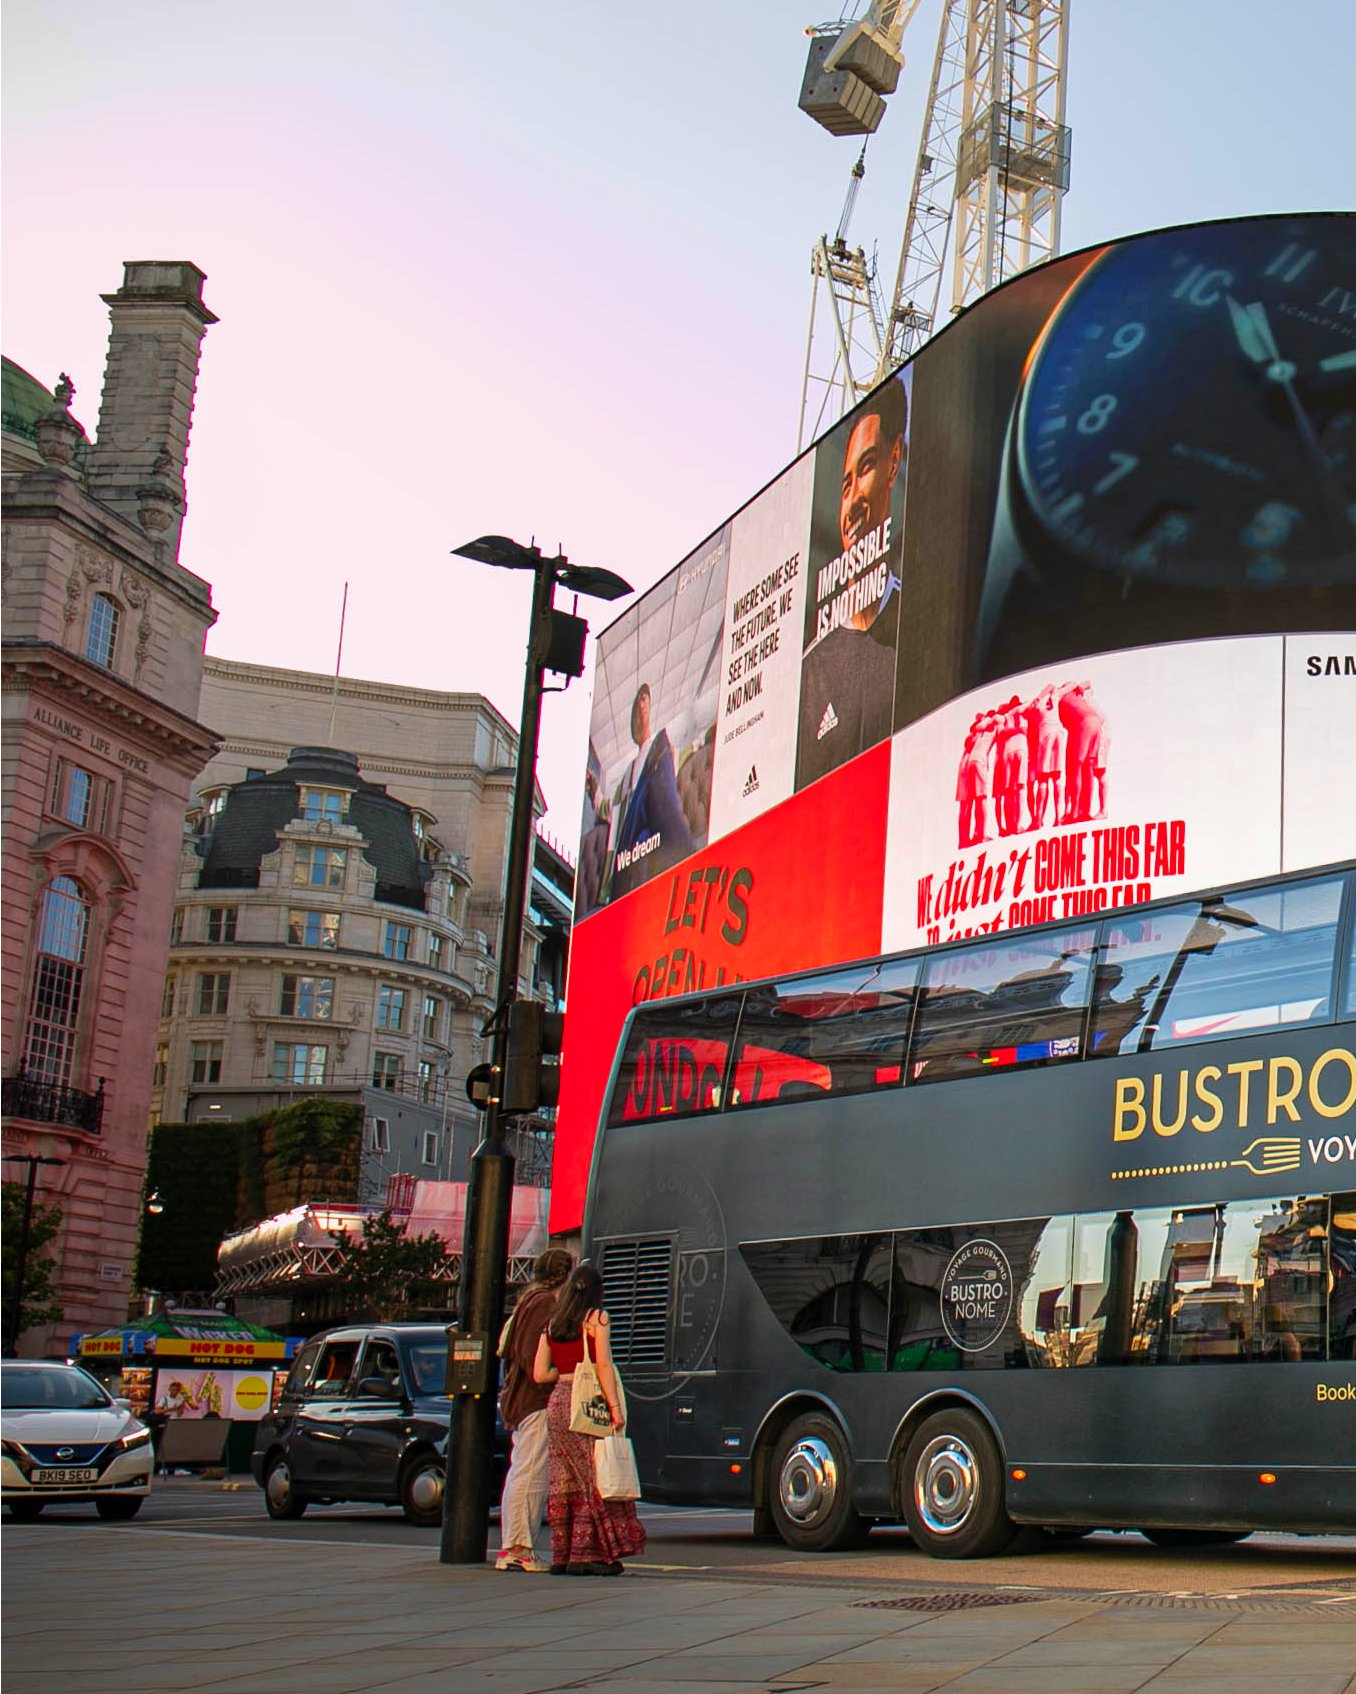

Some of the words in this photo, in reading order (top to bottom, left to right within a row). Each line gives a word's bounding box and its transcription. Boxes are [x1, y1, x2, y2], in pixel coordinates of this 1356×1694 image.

[1105, 322, 1147, 360] 9
[1077, 394, 1118, 434] 8
[1092, 451, 1140, 497] 7
[817, 516, 892, 603] IMPOSSIBLE
[733, 585, 760, 624] WHERE
[760, 565, 784, 603] SOME
[784, 552, 800, 585] SEE
[816, 604, 830, 642] IS
[830, 562, 887, 632] NOTHING
[731, 625, 746, 654] THE
[779, 587, 794, 618] WE
[728, 656, 743, 685] SEE
[743, 644, 759, 675] THE
[759, 628, 780, 664] HERE
[726, 686, 743, 717] AND
[743, 671, 763, 703] NOW.
[33, 707, 83, 741] ALLIANCE
[90, 734, 111, 755] LIFE
[117, 749, 148, 774] OFFICE
[617, 849, 631, 872] We
[631, 832, 661, 863] dream
[917, 874, 933, 929] WE
[1034, 832, 1087, 893] COME
[1092, 824, 1140, 884] THIS
[1143, 820, 1185, 877] FAR
[664, 866, 754, 946] LET'S
[947, 1249, 971, 1282] VOYAGE
[972, 1246, 1008, 1281] GOURMAND
[950, 1282, 1003, 1302] BUSTRO
[955, 1301, 997, 1320] NOME
[86, 1342, 101, 1352] HOT
[104, 1341, 121, 1351] DOG
[191, 1342, 220, 1353] HOT
[224, 1343, 254, 1355] DOG
[1316, 1382, 1356, 1401] Book
[40, 1470, 65, 1480] BK19
